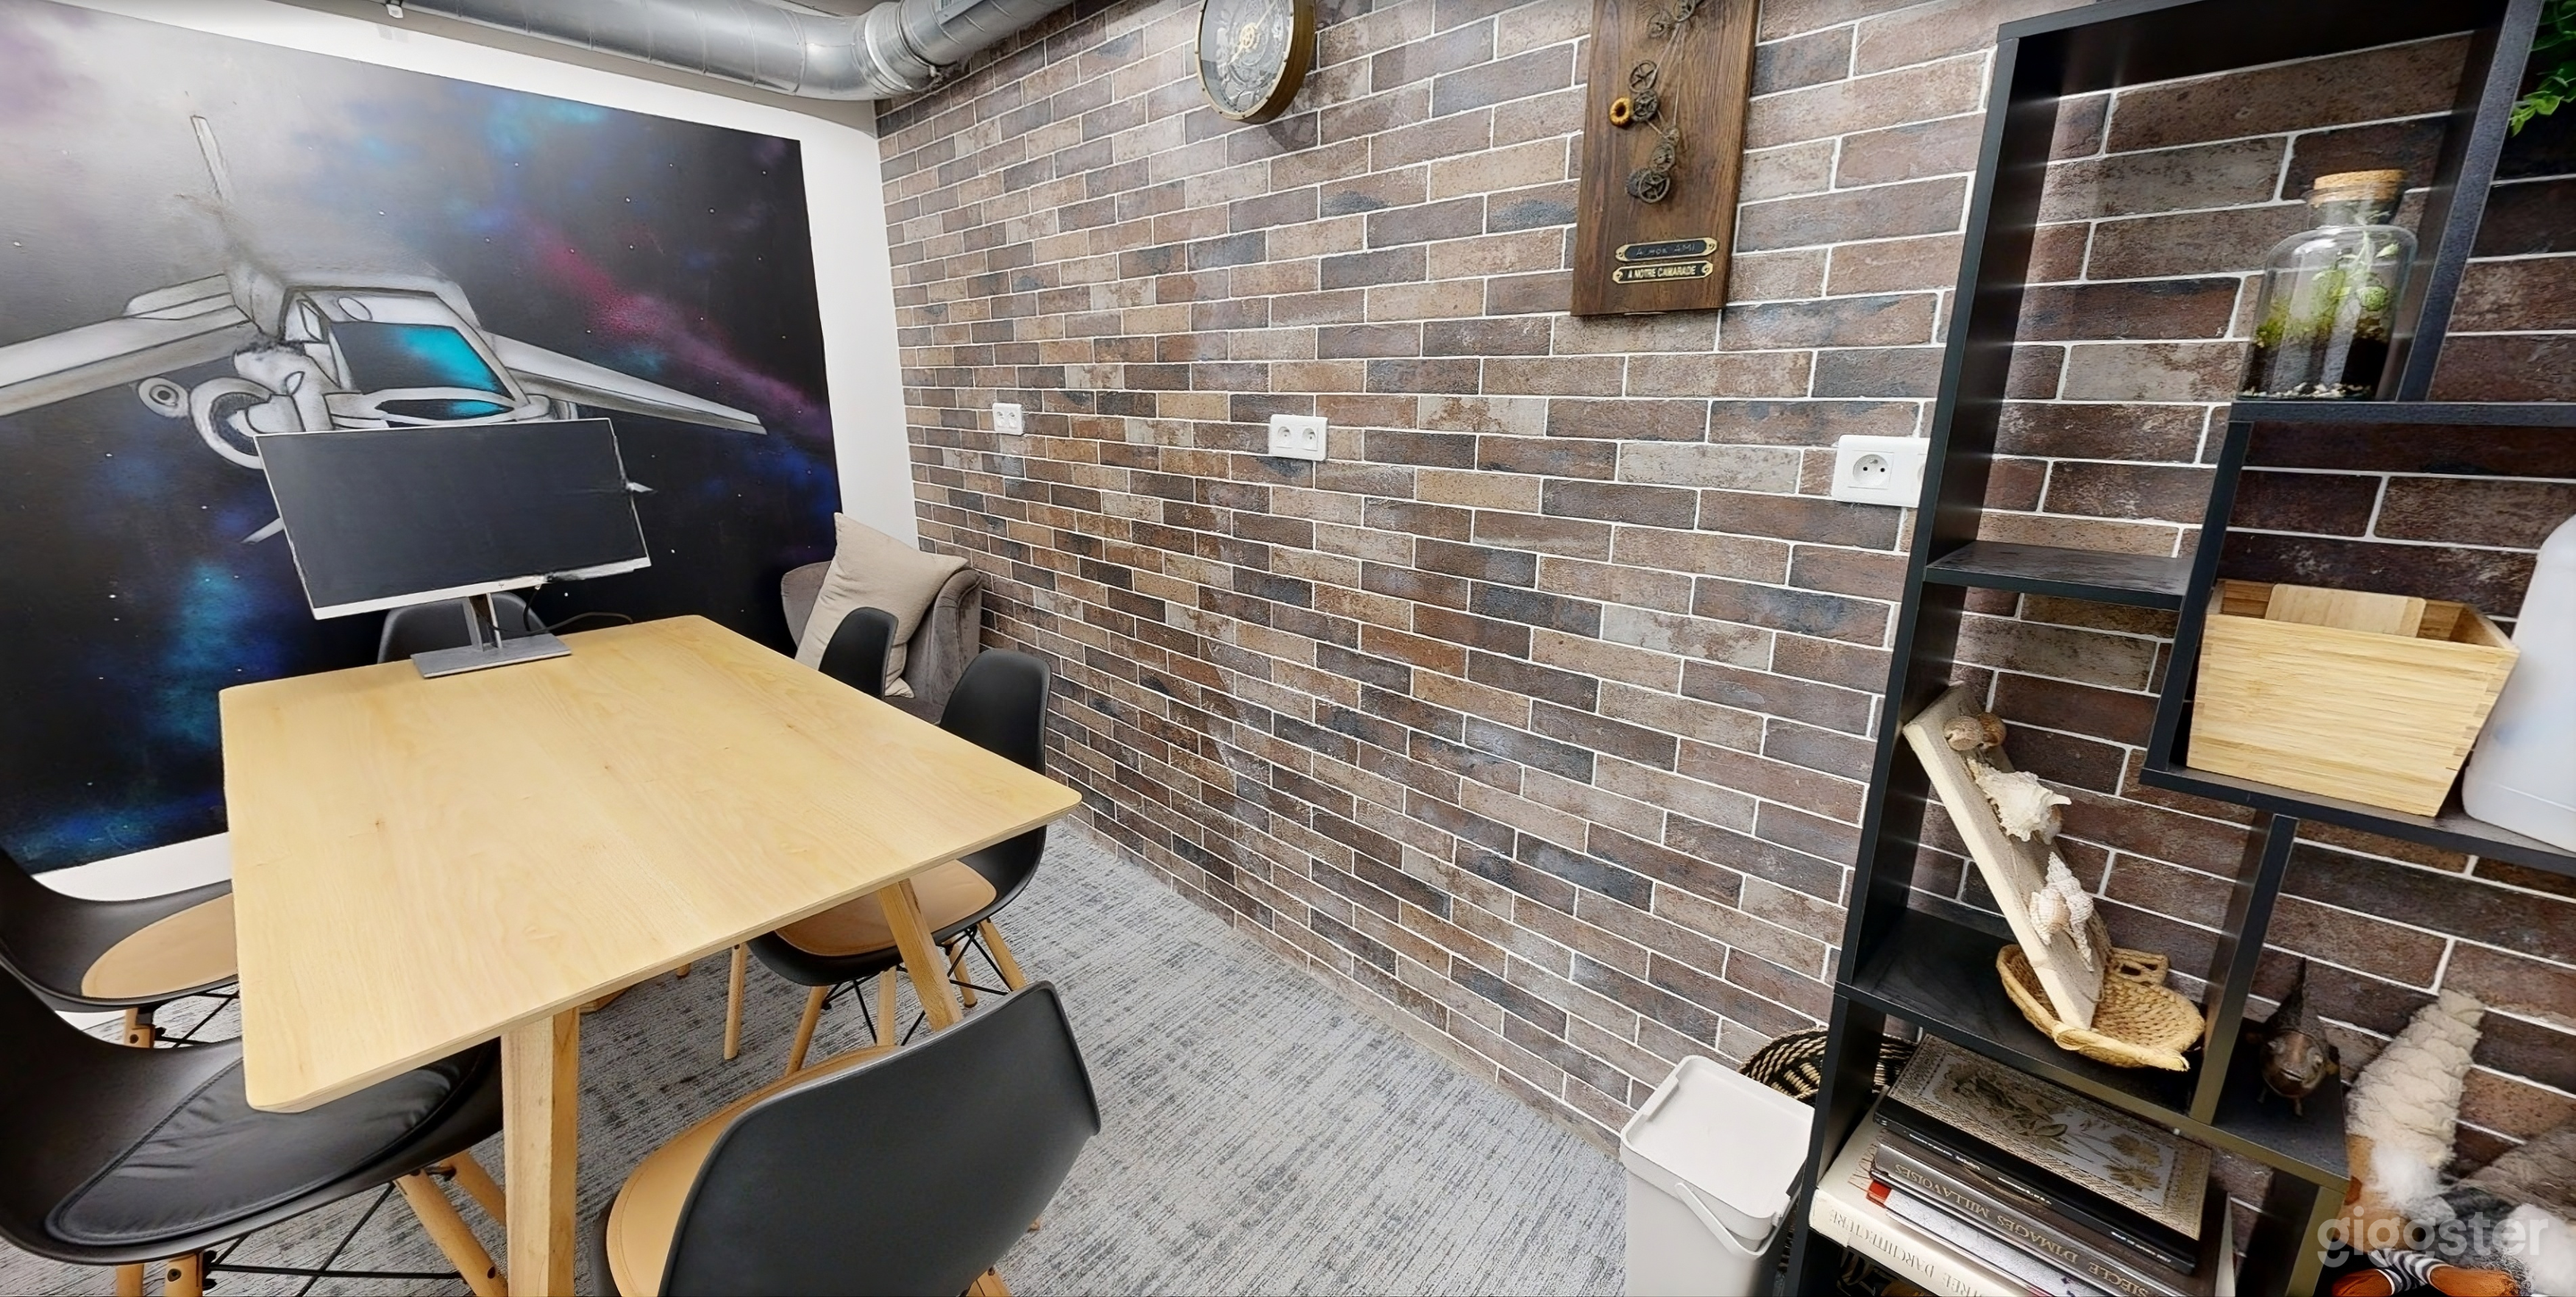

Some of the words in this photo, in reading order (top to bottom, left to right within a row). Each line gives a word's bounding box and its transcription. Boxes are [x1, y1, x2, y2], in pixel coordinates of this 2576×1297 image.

[1634, 268, 1657, 279] NOTRE
[1657, 265, 1697, 277] CAMARADE
[1894, 1164, 1991, 1218] MILLAVOISES
[1996, 1215, 2079, 1266] D'IMAGES
